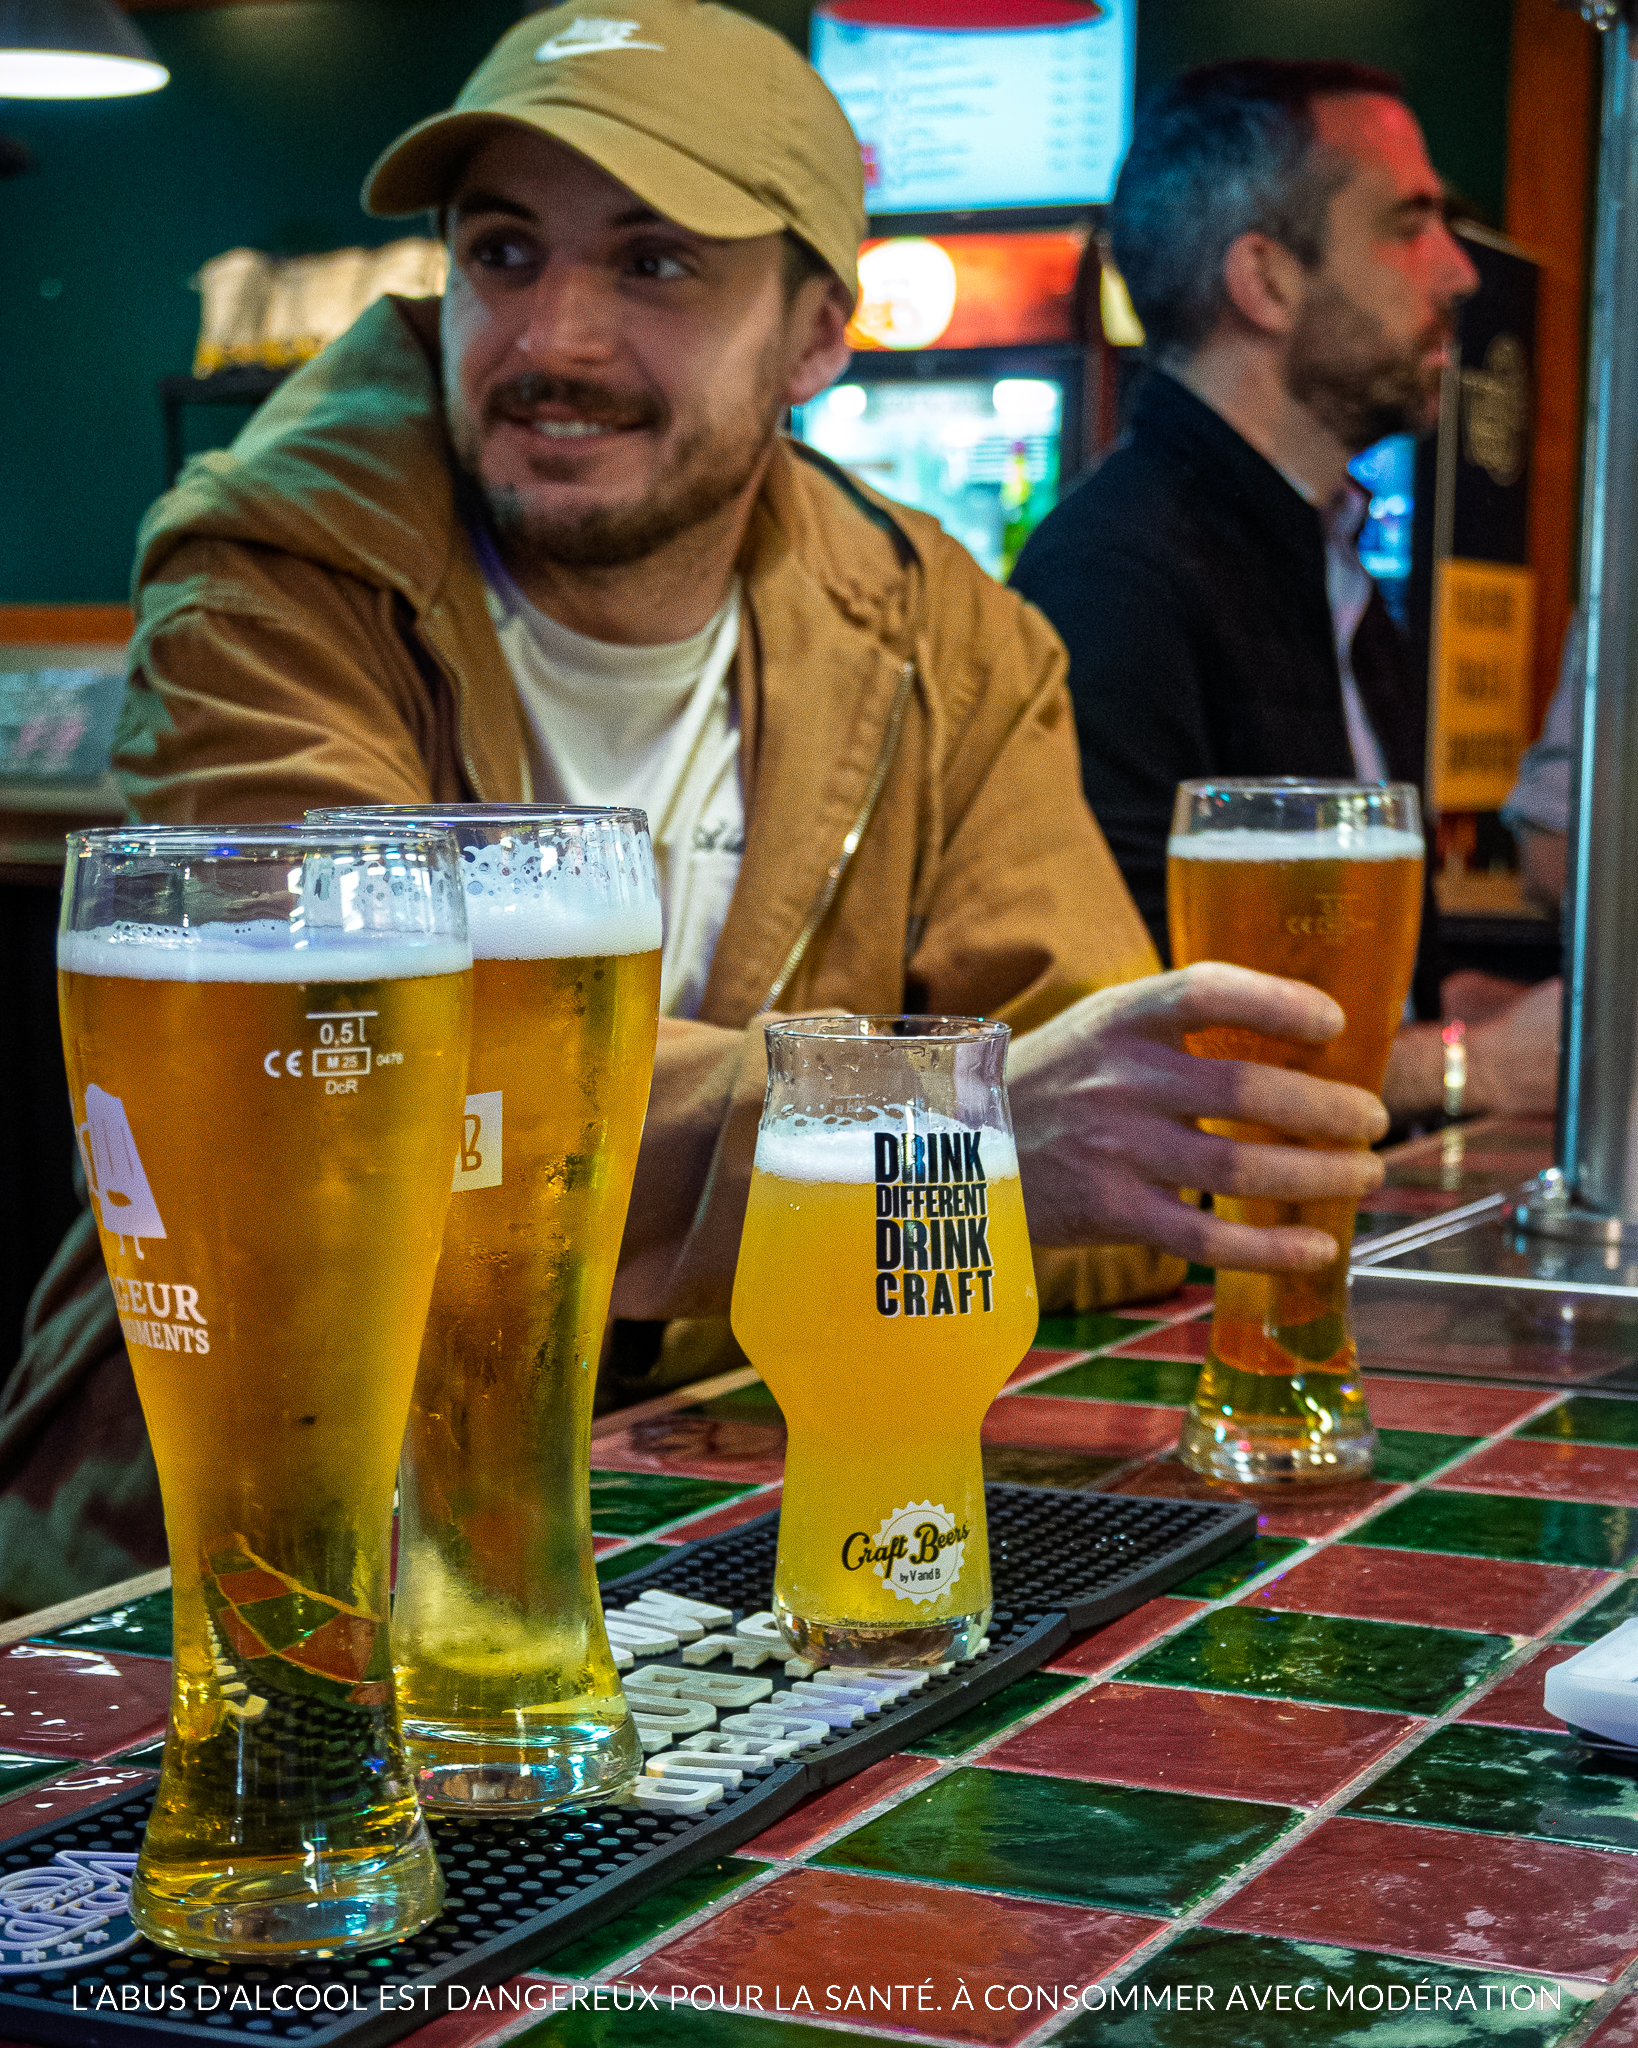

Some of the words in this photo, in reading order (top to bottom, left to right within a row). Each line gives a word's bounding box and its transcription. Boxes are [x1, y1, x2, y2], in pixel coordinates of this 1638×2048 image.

[875, 1132, 986, 1184] DRINK
[876, 1183, 988, 1219] DIFFERENT
[876, 1217, 994, 1272] DRINK
[876, 1269, 995, 1318] CRAFT
[842, 1532, 908, 1579] Craft
[909, 1521, 970, 1565] Beers
[900, 1573, 909, 1583] by
[909, 1570, 917, 1581] V
[917, 1568, 934, 1581] and
[934, 1568, 941, 1580] B
